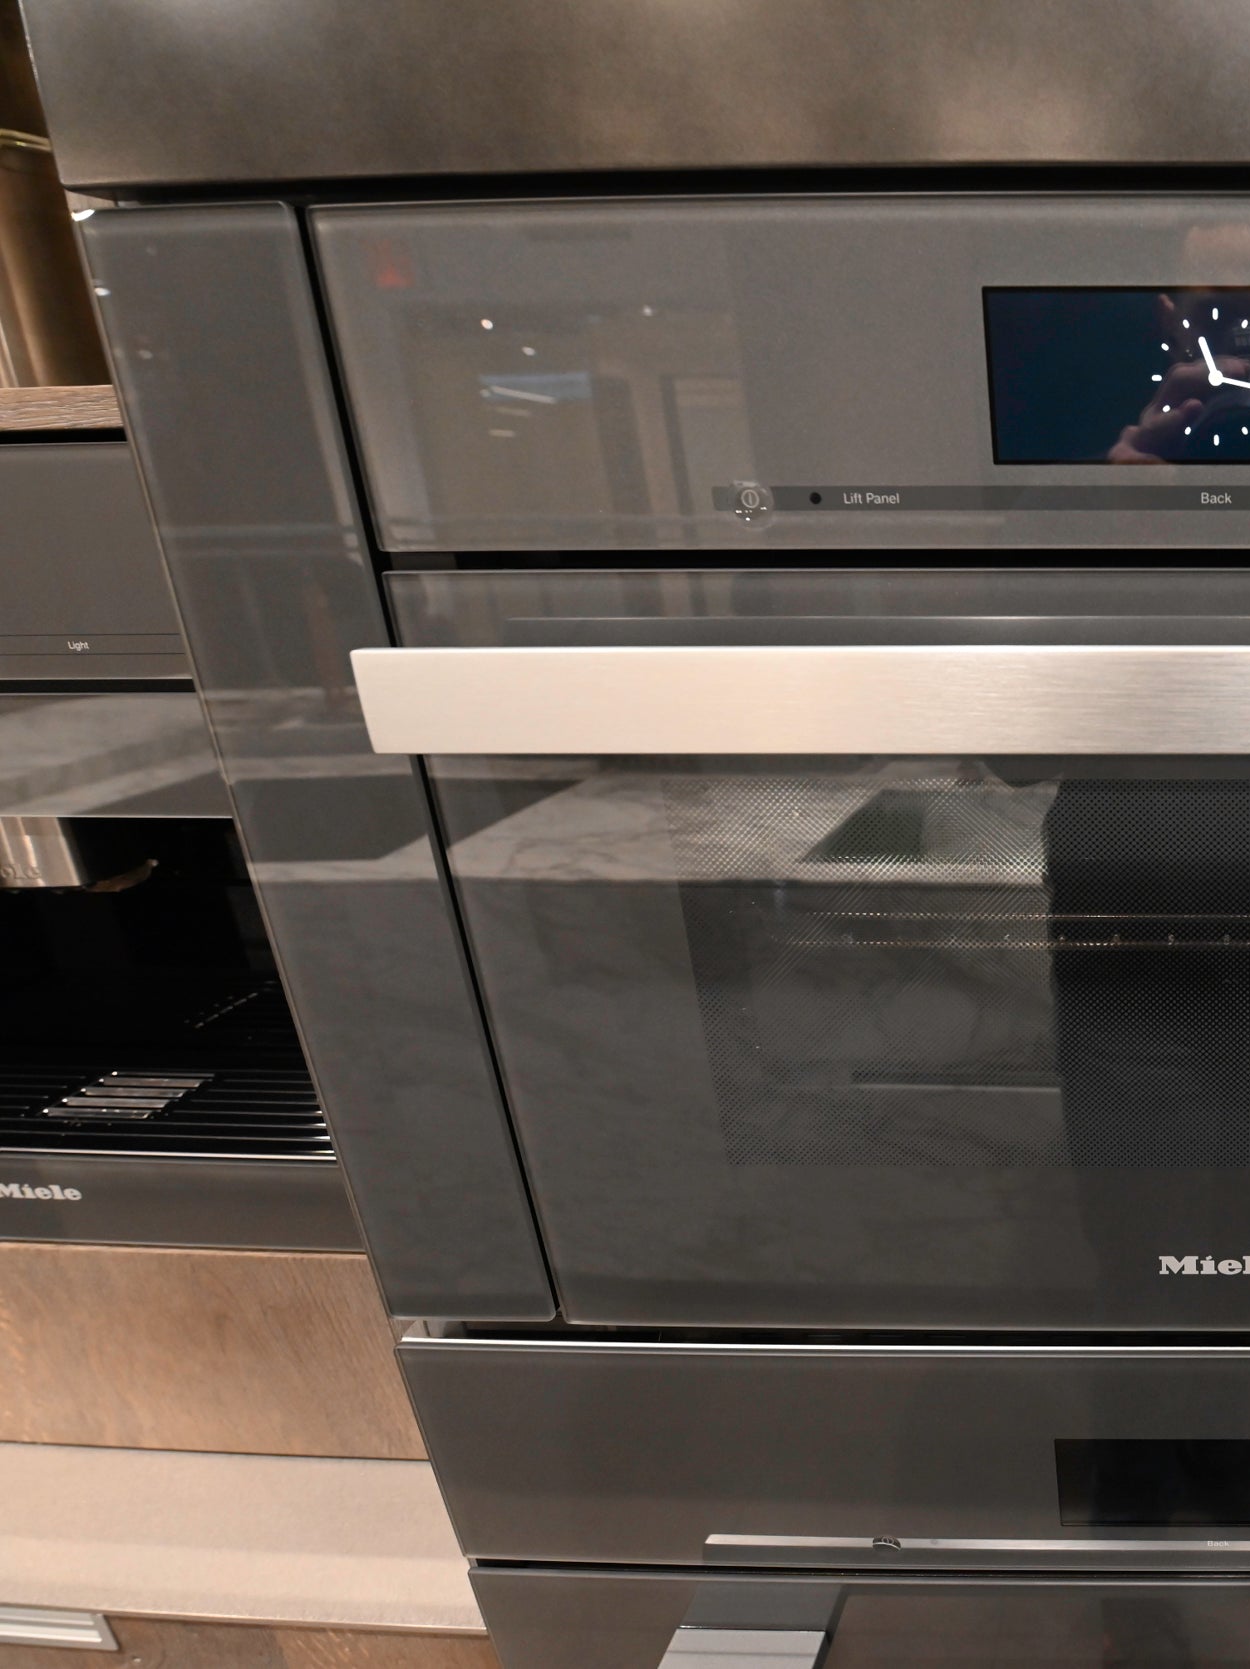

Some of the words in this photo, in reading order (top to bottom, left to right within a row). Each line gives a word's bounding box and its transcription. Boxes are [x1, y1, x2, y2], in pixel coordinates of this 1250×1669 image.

[842, 492, 863, 505] Lift
[865, 492, 901, 505] Panel
[1200, 491, 1233, 505] Back
[67, 640, 90, 652] Light
[0, 1183, 82, 1201] Miele
[1207, 1540, 1231, 1548] Back
